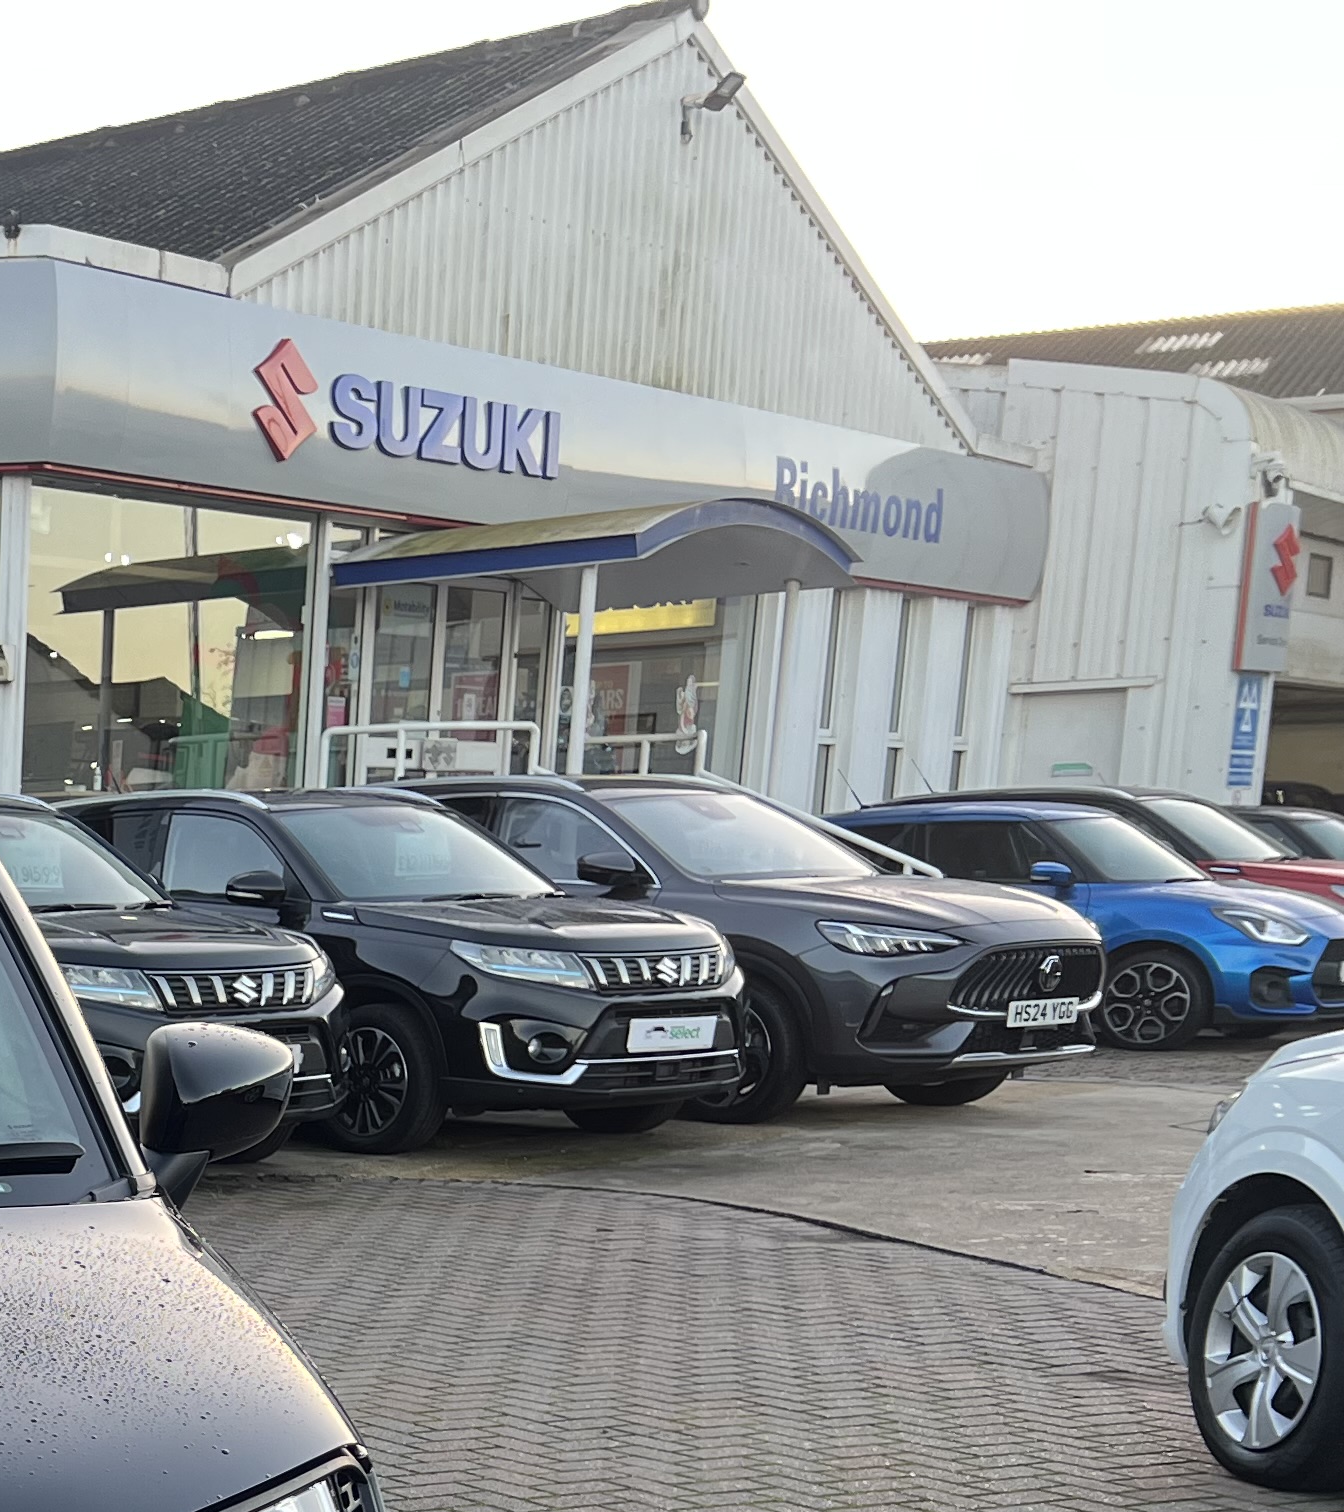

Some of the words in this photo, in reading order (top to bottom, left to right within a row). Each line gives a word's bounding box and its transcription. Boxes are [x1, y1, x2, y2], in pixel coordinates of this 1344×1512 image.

[329, 374, 560, 479] SUZUKI
[774, 455, 944, 543] Richmond
[1014, 1003, 1048, 1023] HS24
[1052, 1001, 1074, 1020] YGG
